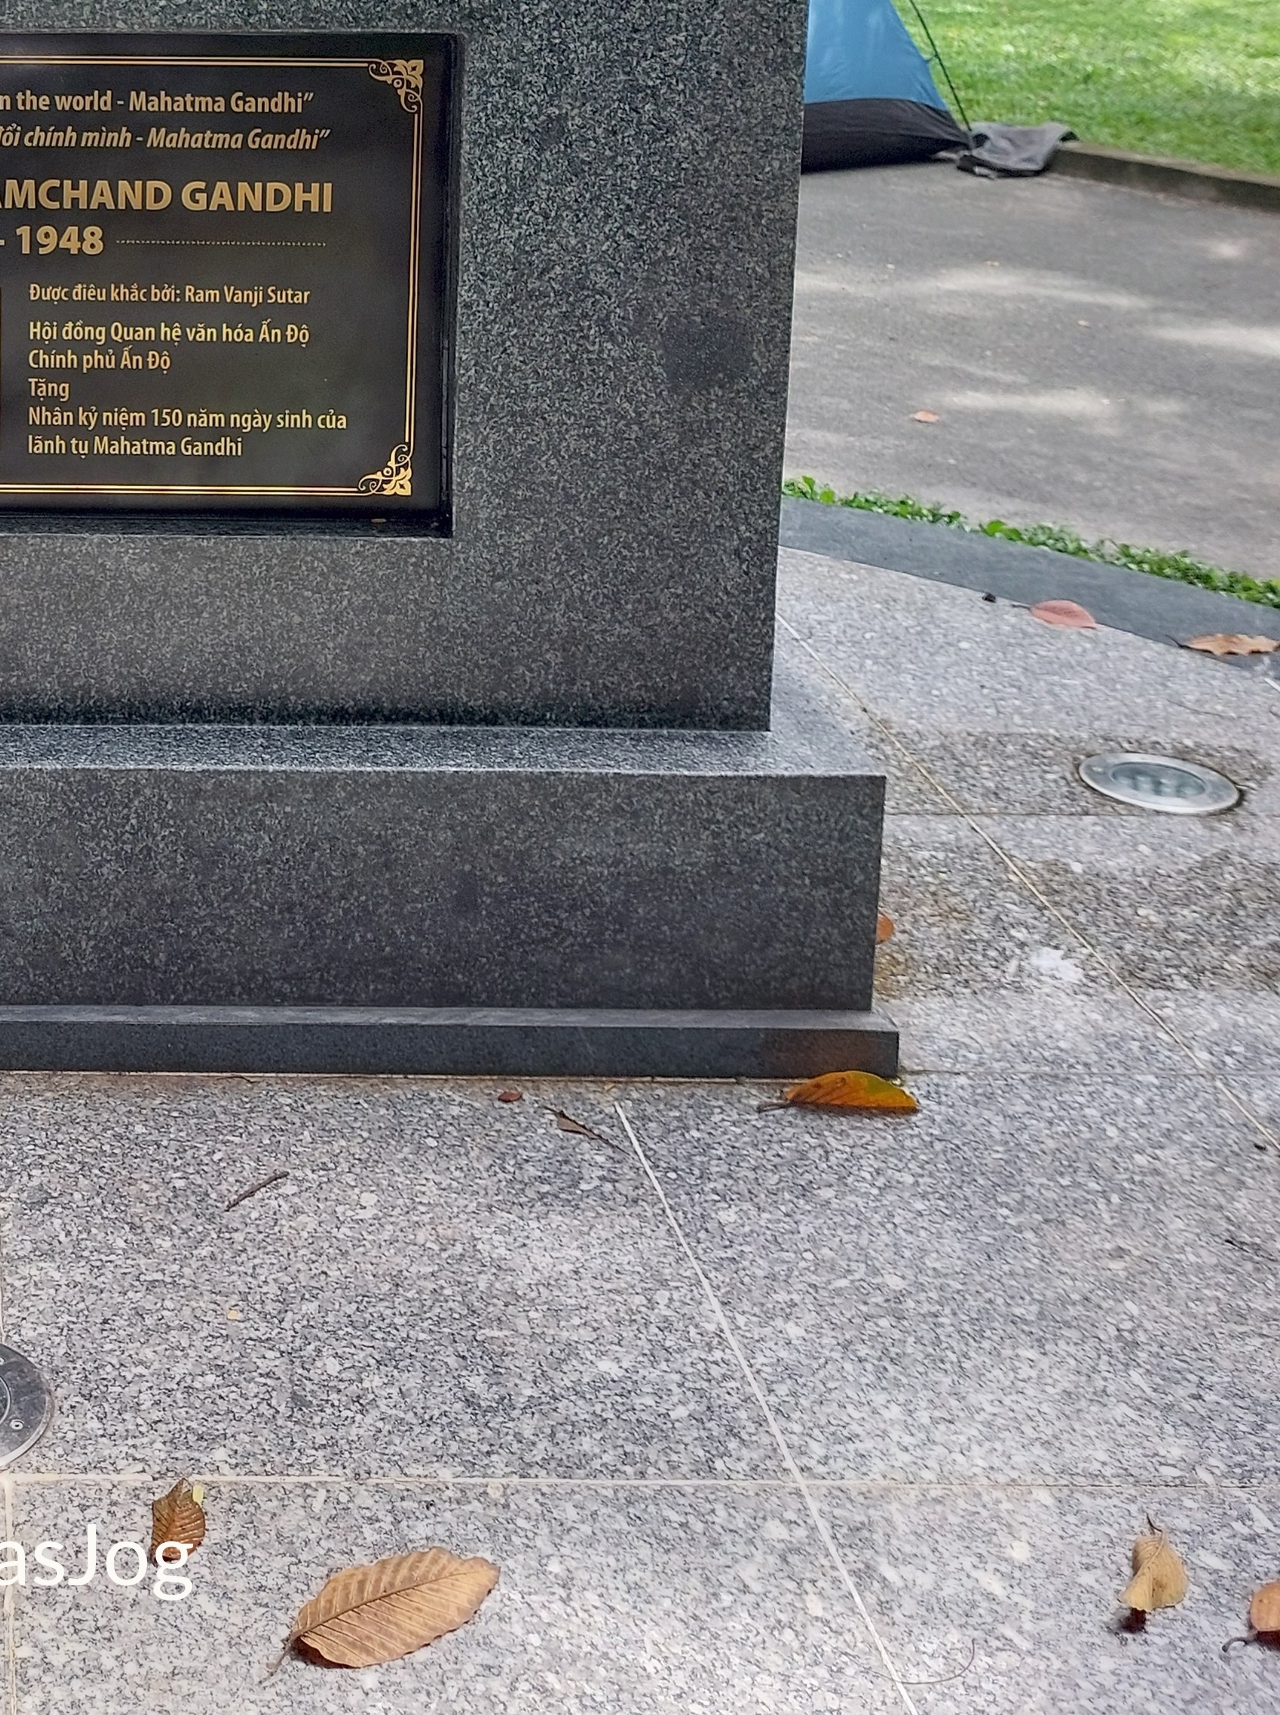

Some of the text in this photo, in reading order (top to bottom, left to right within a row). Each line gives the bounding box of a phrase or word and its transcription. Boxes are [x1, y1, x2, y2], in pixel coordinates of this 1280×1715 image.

[15, 89, 50, 111] the
[54, 90, 112, 111] world
[128, 90, 225, 113] Mahatma
[230, 91, 314, 113] Gandhi”
[23, 125, 77, 147] chính
[80, 126, 132, 148] mình
[146, 127, 244, 149] Mahatma
[247, 128, 331, 150] Gandhi”
[181, 180, 333, 213] GANDHI
[15, 225, 104, 255] 1948
[29, 282, 311, 308] Được điêu khắc bởi: Ram Vanji Sutar
[29, 318, 310, 348] Hội đồng Quan hệ văn hóa Ấn Độ
[28, 344, 171, 375] Chính phủ Ấn Độ
[27, 377, 70, 402] Tặng
[28, 405, 347, 433] Nhân kỷ niệm 150 năm ngày sinh của
[28, 434, 243, 459] lãnh tụ Mahatma Gandhi
